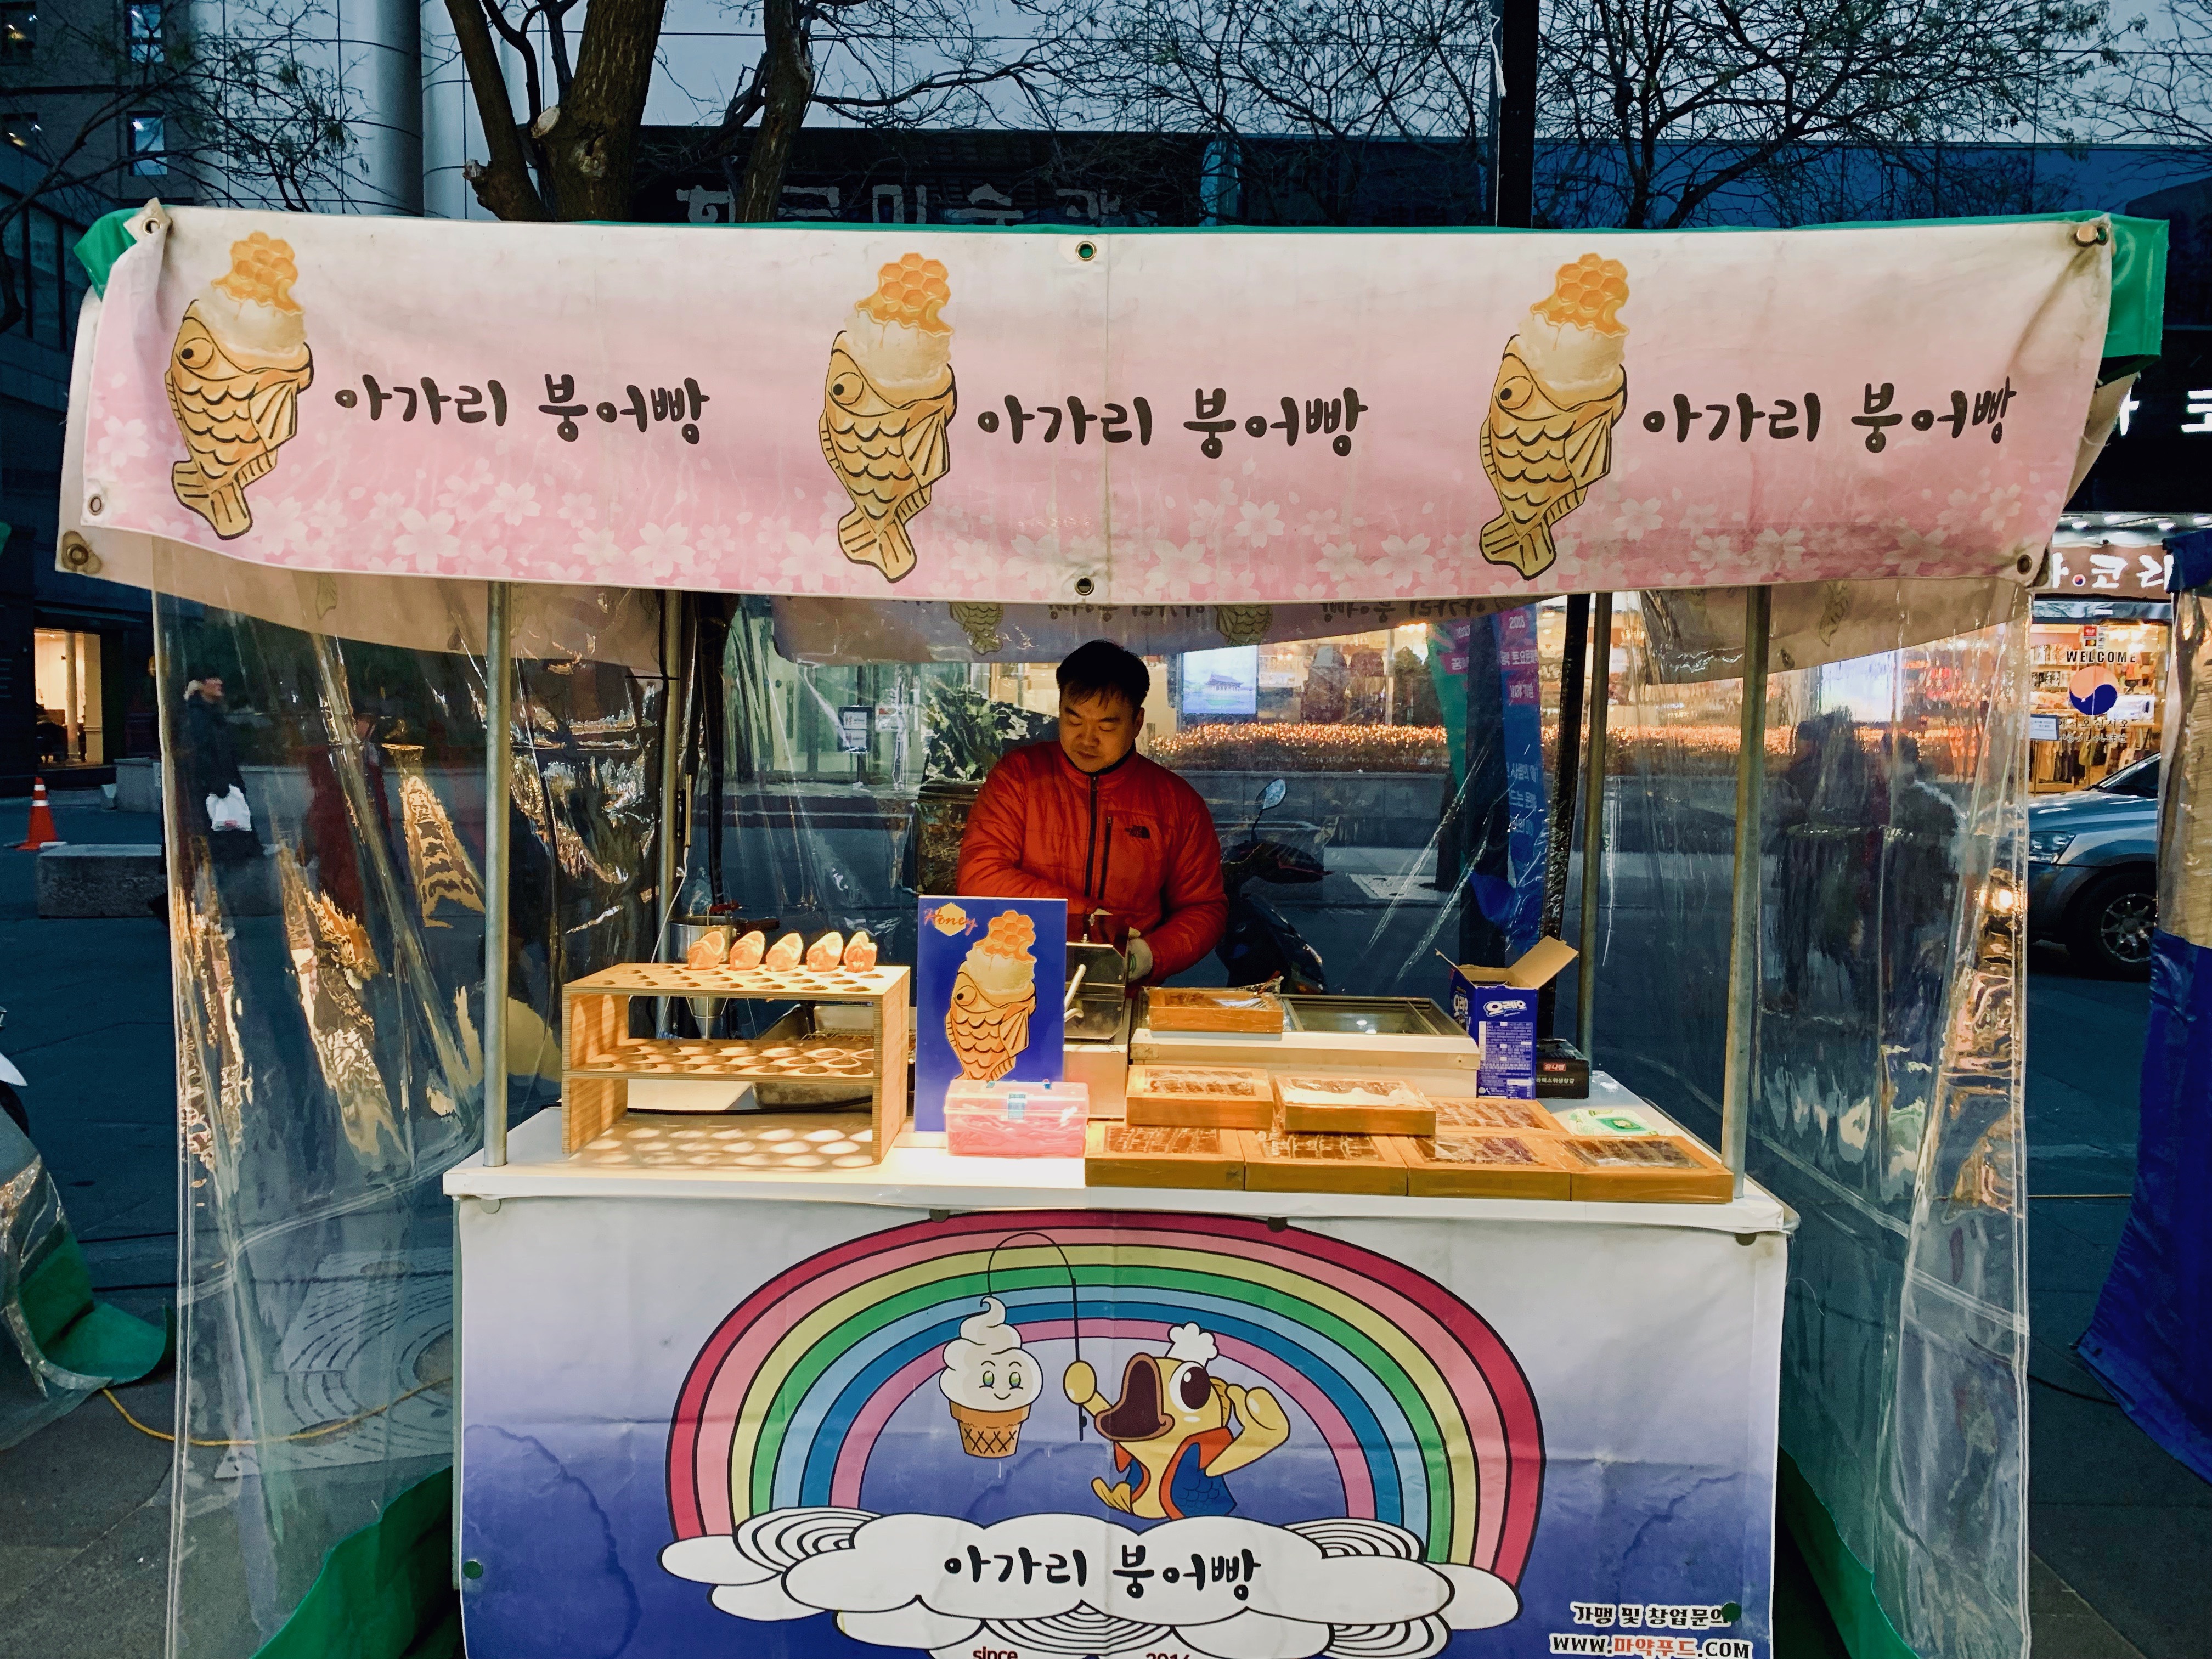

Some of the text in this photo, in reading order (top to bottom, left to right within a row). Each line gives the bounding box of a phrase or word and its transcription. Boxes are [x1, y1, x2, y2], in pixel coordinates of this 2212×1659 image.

[335, 374, 710, 444] 아가리 붕어빵
[1643, 376, 2017, 454] 아가리 붕어빵
[978, 387, 1368, 459] 아가리 붕어빵
[2066, 651, 2135, 662] WELCOME
[2060, 718, 2129, 729] 어서오십시오
[923, 907, 978, 936] Honey
[1485, 1000, 1526, 1016] 오레오
[944, 1545, 1261, 1600] 아가리 붕어빵
[1573, 1605, 1613, 1624] 가맹
[1622, 1607, 1640, 1625] 및
[973, 1646, 1018, 1659] since
[1553, 1637, 1751, 1659] WWW.마약푸드.COM
